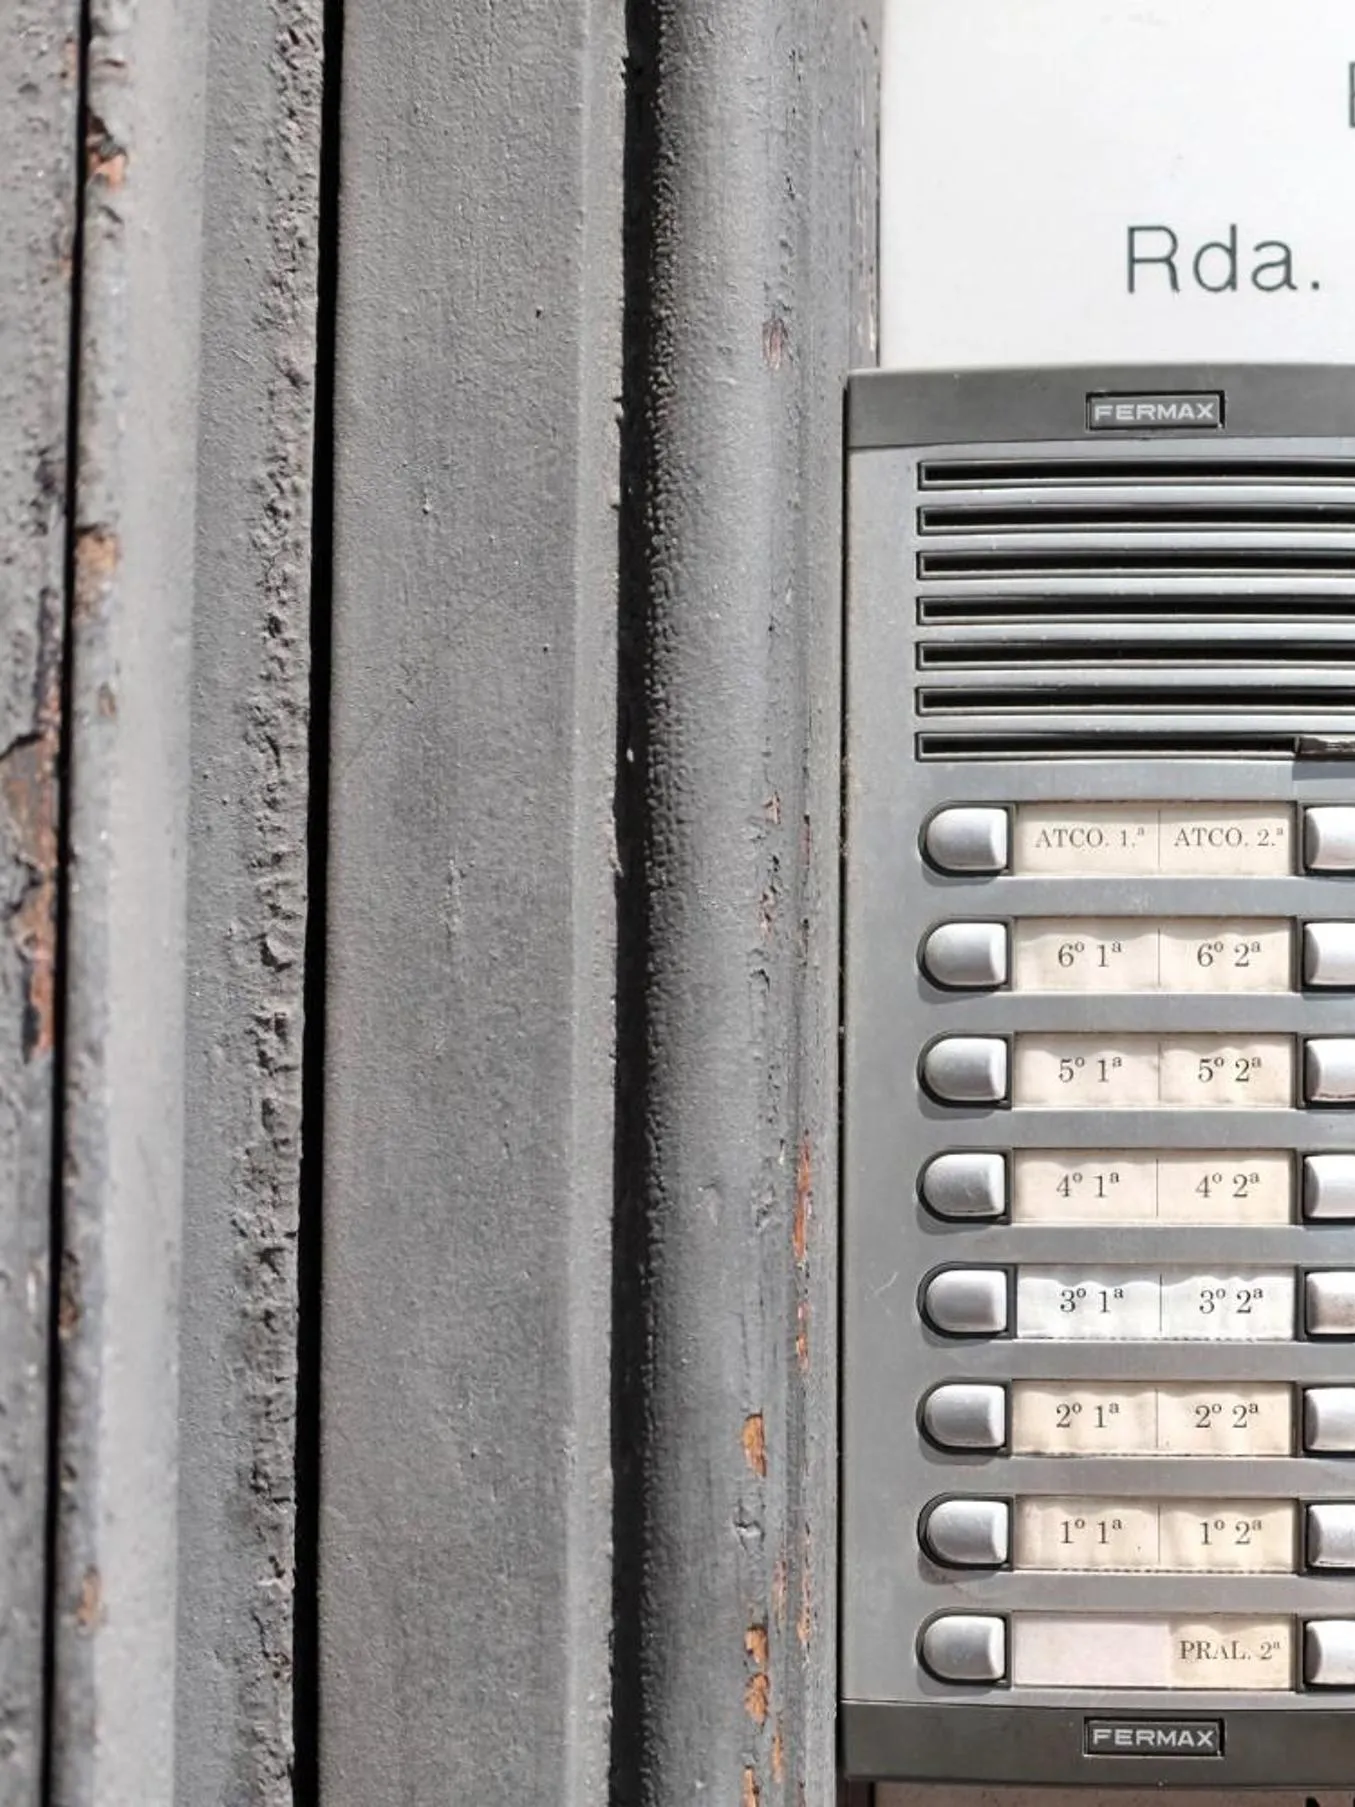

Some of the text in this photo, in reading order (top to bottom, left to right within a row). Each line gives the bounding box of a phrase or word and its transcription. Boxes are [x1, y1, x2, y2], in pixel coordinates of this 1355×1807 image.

[1126, 223, 1321, 296] Rda.
[1094, 402, 1215, 421] FERMAX
[1035, 828, 1109, 849] ATCO.
[1174, 828, 1248, 847] ATCO.
[1180, 1640, 1251, 1660] PRAL.
[1093, 1729, 1214, 1746] FERMAX
